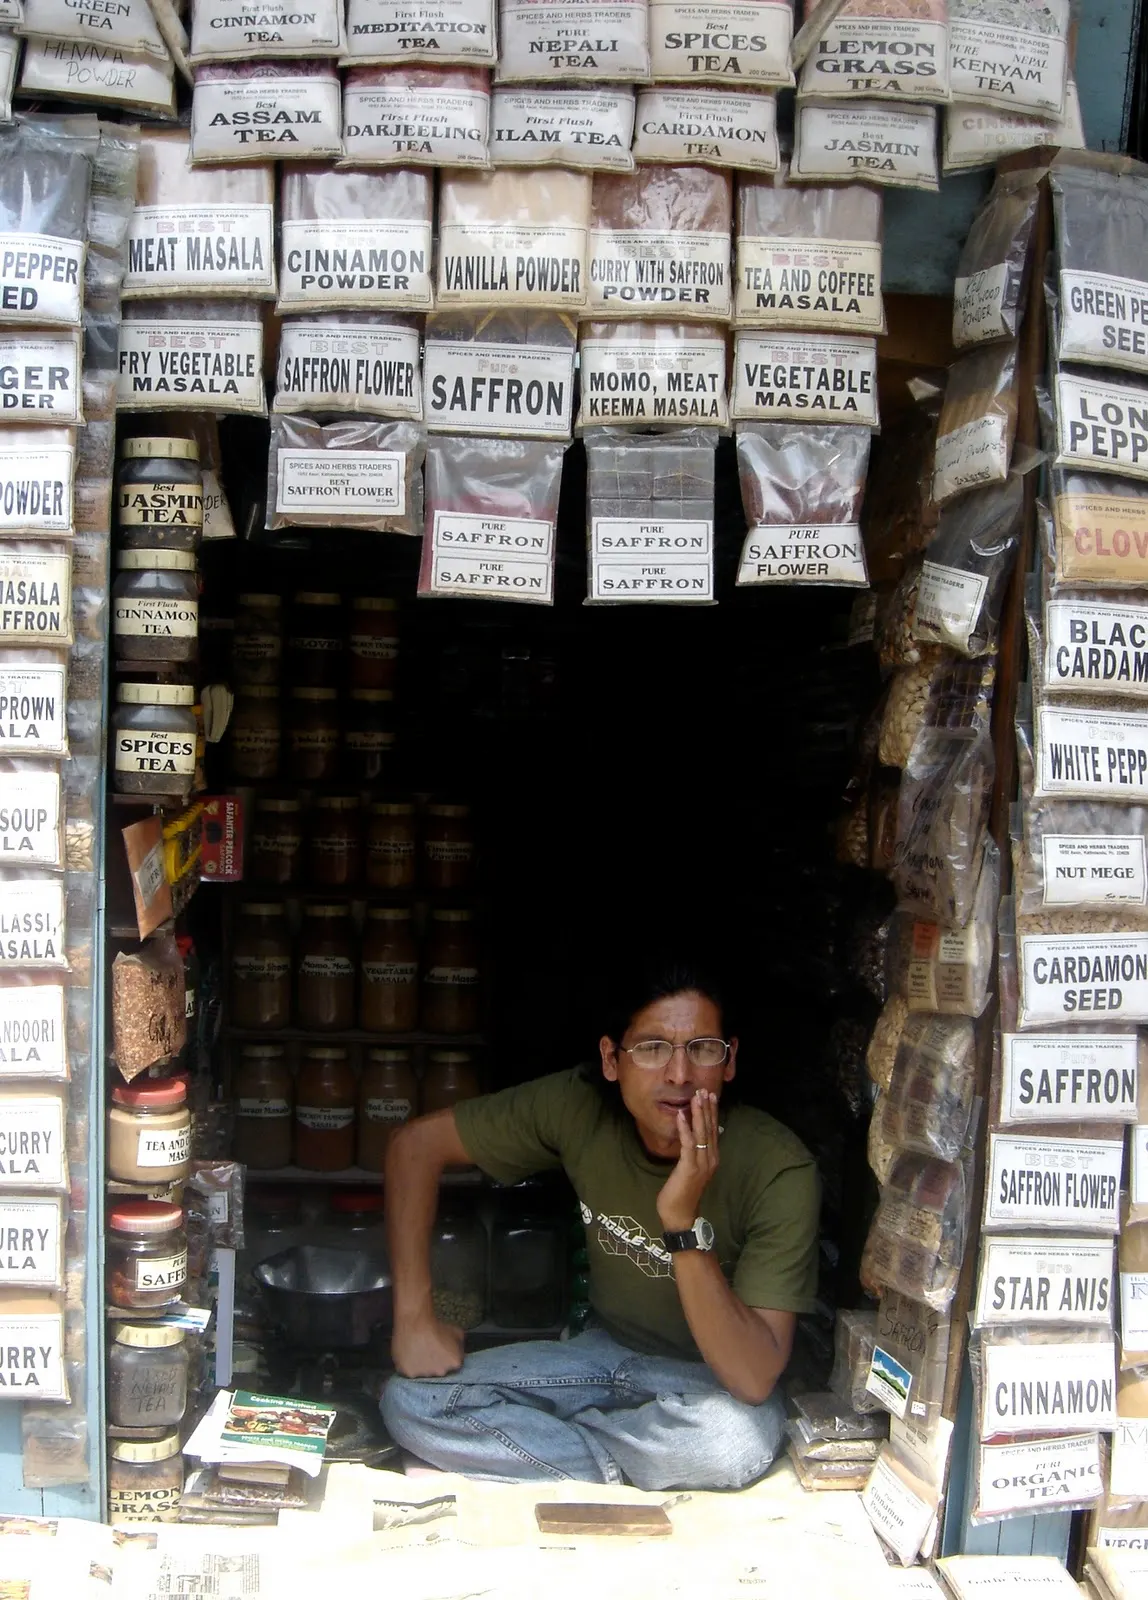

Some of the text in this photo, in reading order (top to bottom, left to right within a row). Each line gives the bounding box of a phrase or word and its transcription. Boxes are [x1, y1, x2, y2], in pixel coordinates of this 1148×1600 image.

[64, 0, 131, 17] GREEN
[395, 10, 445, 19] First Flush
[516, 12, 544, 20] SPICES
[594, 11, 632, 19] TRADERS
[76, 12, 113, 30] TEA
[210, 12, 317, 29] CINNAMON
[705, 22, 729, 31] Best
[244, 31, 284, 43] TEA
[351, 22, 488, 36] MEDITATION
[556, 28, 591, 37] PURE
[397, 37, 441, 50] TEA
[664, 33, 768, 52] SPICES
[951, 26, 1050, 49] SPICES AND HERBS TRADERS
[528, 39, 619, 53] NEPALI
[818, 39, 936, 58] LEMON
[949, 43, 980, 56] PURE
[549, 55, 599, 69] TEA
[687, 55, 742, 74] TEA
[815, 58, 937, 76] GRASS
[1012, 54, 1050, 69] NEPAL
[65, 60, 137, 88] POWDER
[951, 57, 1043, 84] KENYAM
[847, 78, 903, 91] TEA
[974, 75, 1016, 95] TEA
[255, 100, 276, 109] Best
[209, 110, 323, 127] ASSAM
[381, 113, 448, 124] First Flush
[526, 115, 594, 127] First Flush
[679, 112, 734, 124] First Flush
[233, 128, 299, 144] TEA
[346, 124, 482, 142] DARJEELING
[496, 128, 623, 147] ILAM TEA
[642, 121, 767, 144] CARDAMON
[862, 131, 884, 140] Best
[393, 140, 433, 154] TEA
[683, 143, 723, 157] TEA
[824, 139, 921, 157] JASMIN
[847, 155, 898, 171] TEA
[156, 220, 236, 234] BEST
[128, 235, 265, 273] MEAT MASALA
[287, 248, 426, 274] CINNAMON
[771, 253, 850, 269] BEST
[3, 251, 79, 286] PEPPER
[444, 255, 581, 293] VANILLA POWDER
[590, 258, 724, 287] CURRY WITH SAFFRON
[300, 274, 410, 290] POWDER
[744, 266, 876, 297] TEA AND COFFEE
[602, 285, 711, 304] POWDER
[755, 292, 862, 314] MASALA
[1071, 286, 1126, 321] GREEN
[147, 335, 228, 349] BEST
[309, 340, 389, 356] BEST
[119, 350, 256, 378] FRY VEGETABLE
[771, 350, 849, 367] BEST
[477, 359, 519, 375] Pure
[132, 376, 240, 394] MASALA
[283, 357, 414, 398] SAFFRON FLOWER
[590, 372, 719, 395] MOMO, MEAT
[744, 363, 872, 395] VEGETABLE
[430, 374, 565, 416] SAFFRON
[755, 391, 859, 412] MASALA
[590, 397, 720, 418] KEEMA MASALA
[332, 463, 357, 471] HERBS
[358, 463, 393, 471] TRADERS
[152, 483, 176, 492] Best
[287, 486, 394, 497] SAFFRON FLOWER
[120, 493, 203, 509] JASMIN
[137, 508, 188, 524] TEA
[481, 522, 507, 532] PURE
[640, 526, 665, 534] PURE
[788, 530, 821, 540] PURE
[441, 531, 545, 548] SAFFRON
[601, 537, 704, 548] SAFFRON
[748, 543, 858, 560] SAFFRON
[479, 563, 504, 572] PURE
[641, 567, 667, 576] PURE
[757, 563, 829, 577] FLOWER
[440, 571, 543, 588] SAFFRON
[603, 578, 705, 590] SAFFRON
[158, 600, 179, 609] Flush
[116, 609, 198, 622] CINNAMON
[142, 623, 172, 635] TEA
[1070, 618, 1147, 649] BLAC
[0, 696, 55, 721] PROWN
[150, 732, 168, 740] Best
[120, 739, 193, 756] SPICES
[136, 757, 177, 773] TEA
[1049, 742, 1148, 786] WHITE PEPP
[0, 808, 48, 832] SOUP
[225, 839, 235, 876] PEACOCK
[1055, 867, 1135, 879] NUT MEGE
[1032, 953, 1148, 985] CARDAMON
[1063, 988, 1123, 1012] SEED
[1019, 1068, 1135, 1104] SAFFRON
[146, 1139, 184, 1151] TEA AND
[1024, 1152, 1094, 1170] BEST
[999, 1168, 1117, 1210] SAFFRON FLOWER
[992, 1275, 1109, 1311] STAR ANIS
[251, 1396, 317, 1410] Cooking Method
[995, 1378, 1112, 1417] CINNAMON
[992, 1463, 1100, 1489] ORGANIC
[108, 1487, 181, 1501] LEMON
[1025, 1483, 1070, 1499] TEA
[107, 1500, 179, 1513] GRASS
